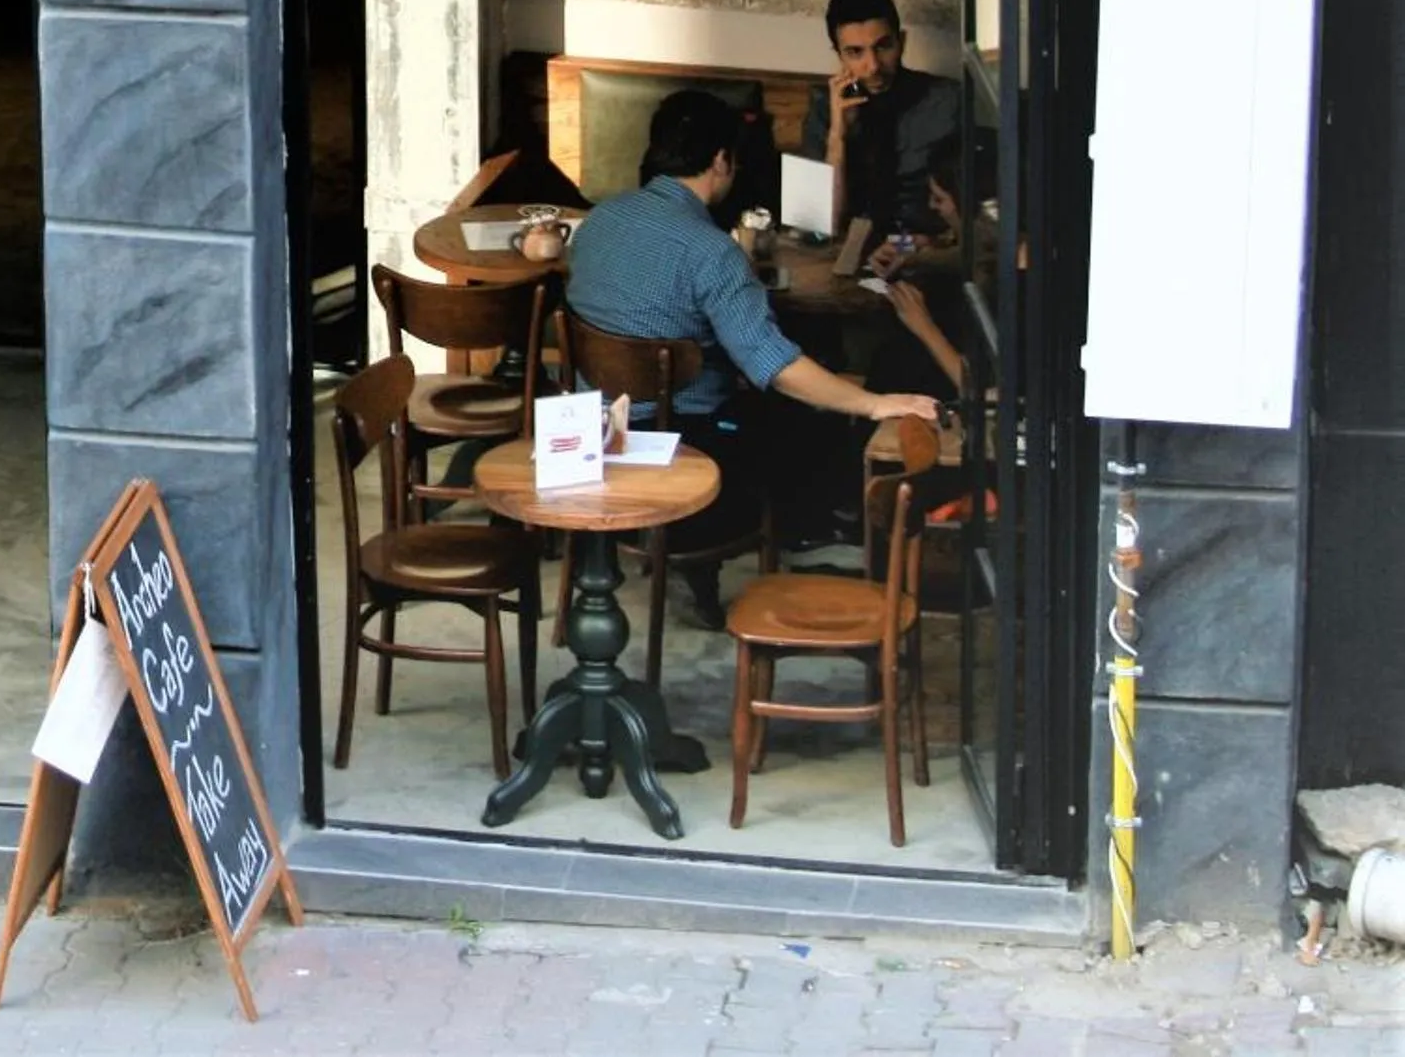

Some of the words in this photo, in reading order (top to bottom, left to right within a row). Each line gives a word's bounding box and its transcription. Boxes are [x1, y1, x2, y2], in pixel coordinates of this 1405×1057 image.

[110, 542, 174, 651] Archeo
[142, 621, 195, 714] Cafe
[185, 754, 231, 842] Take
[213, 817, 268, 927] Away
